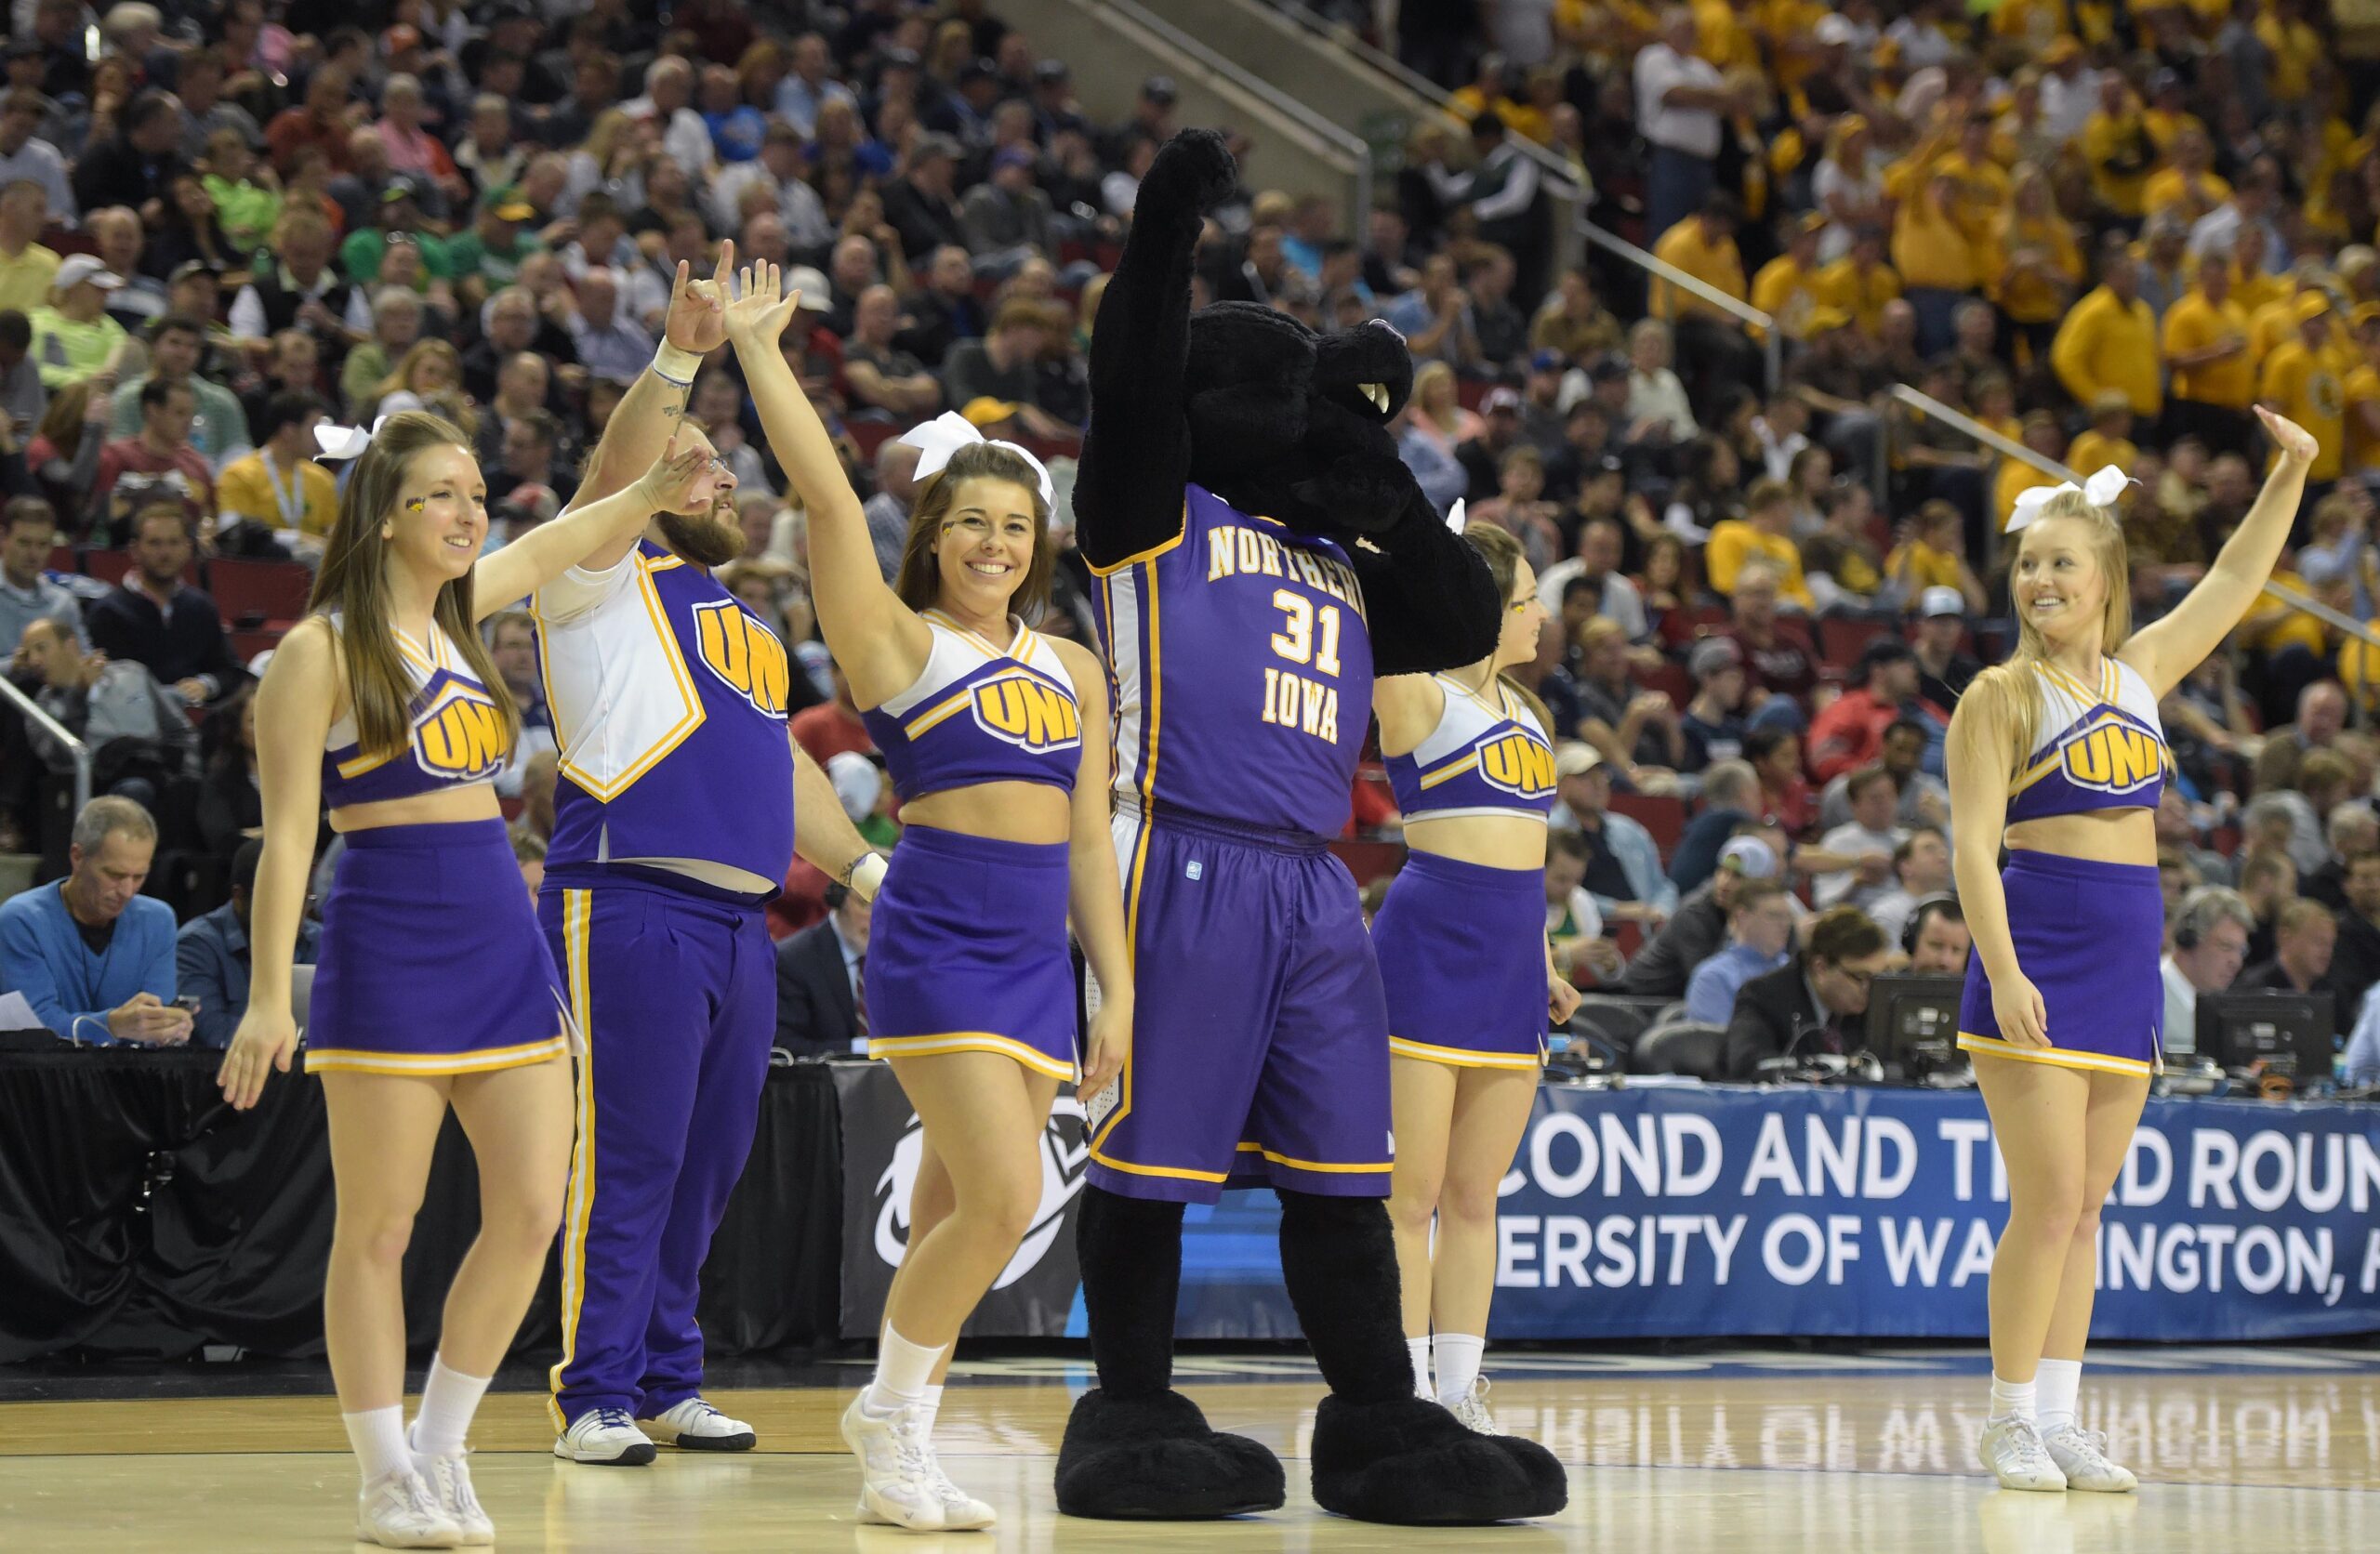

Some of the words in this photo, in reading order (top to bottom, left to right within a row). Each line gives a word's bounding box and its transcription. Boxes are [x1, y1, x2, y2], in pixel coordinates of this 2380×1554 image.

[1271, 588, 1340, 678] 31
[978, 678, 1078, 745] UNI
[1262, 667, 1338, 744] IOWA
[1483, 734, 1557, 792] UNI
[2067, 723, 2159, 787] UNI
[1740, 1113, 1918, 1199] AND
[1762, 1212, 1861, 1286] OF
[1877, 1215, 2346, 1307] WAINGTON,
